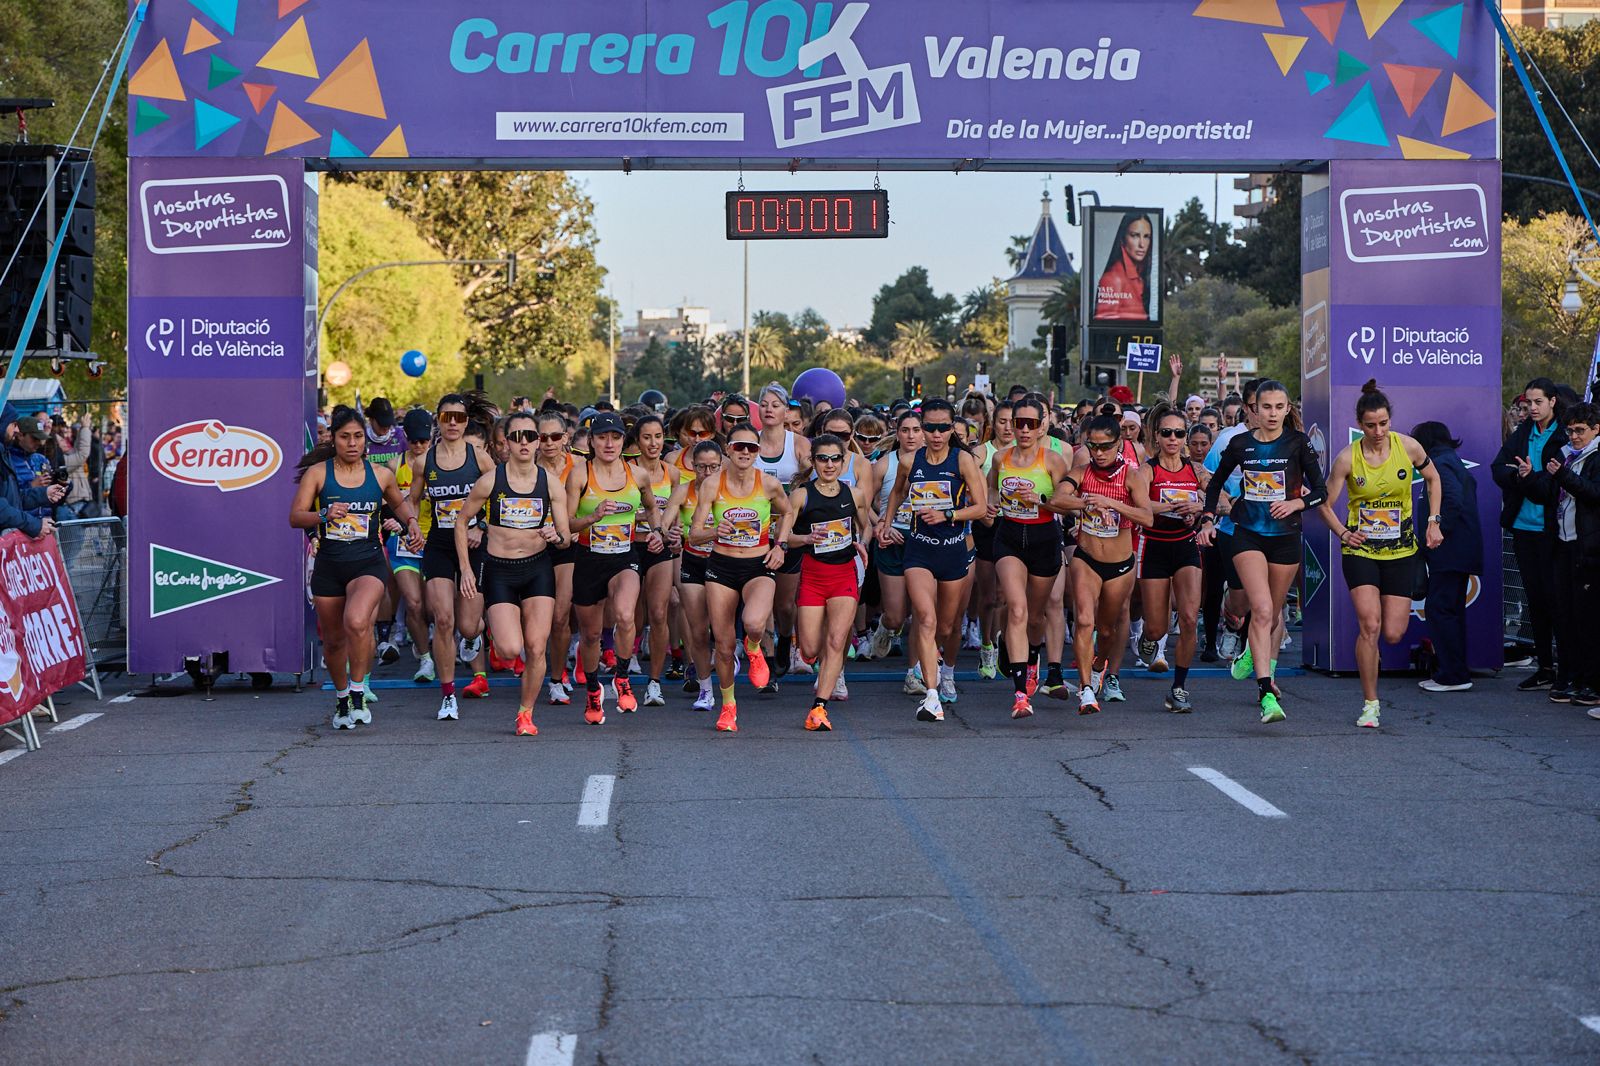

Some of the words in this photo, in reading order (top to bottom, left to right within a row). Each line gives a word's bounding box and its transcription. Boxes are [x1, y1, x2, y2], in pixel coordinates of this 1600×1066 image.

[449, 17, 696, 75] Carrera
[707, 0, 870, 78] 10K
[924, 35, 1141, 81] Valencia
[783, 70, 904, 141] FEM
[513, 117, 728, 136] www.carrera10kfem.com
[946, 119, 982, 139] Día
[988, 119, 1015, 139] de
[1019, 119, 1039, 139] la
[1043, 119, 1253, 145] Mujer...¡Deportista!
[161, 205, 278, 238] Deportistas
[250, 227, 286, 240] .com
[1360, 215, 1477, 247] Deportistas
[1449, 236, 1484, 248] .com
[191, 318, 270, 337] Diputació
[1392, 326, 1469, 346] Diputació
[191, 341, 212, 357] de
[215, 340, 284, 357] València
[1392, 349, 1413, 365] de
[1415, 348, 1483, 365] València
[165, 440, 268, 468] Serrano
[1005, 479, 1032, 488] Serro
[922, 491, 934, 499] 16
[1012, 499, 1018, 507] 9
[449, 508, 458, 518] 4
[505, 507, 534, 516] 3320
[727, 510, 756, 518] Serrano
[340, 522, 351, 531] 13
[1091, 516, 1102, 524] 10
[606, 534, 613, 542] 5
[828, 530, 835, 538] 6
[915, 533, 940, 545] PRO
[15, 543, 54, 594] bien
[155, 571, 169, 586] El
[169, 571, 200, 586] Corte
[200, 568, 247, 591] Inglés
